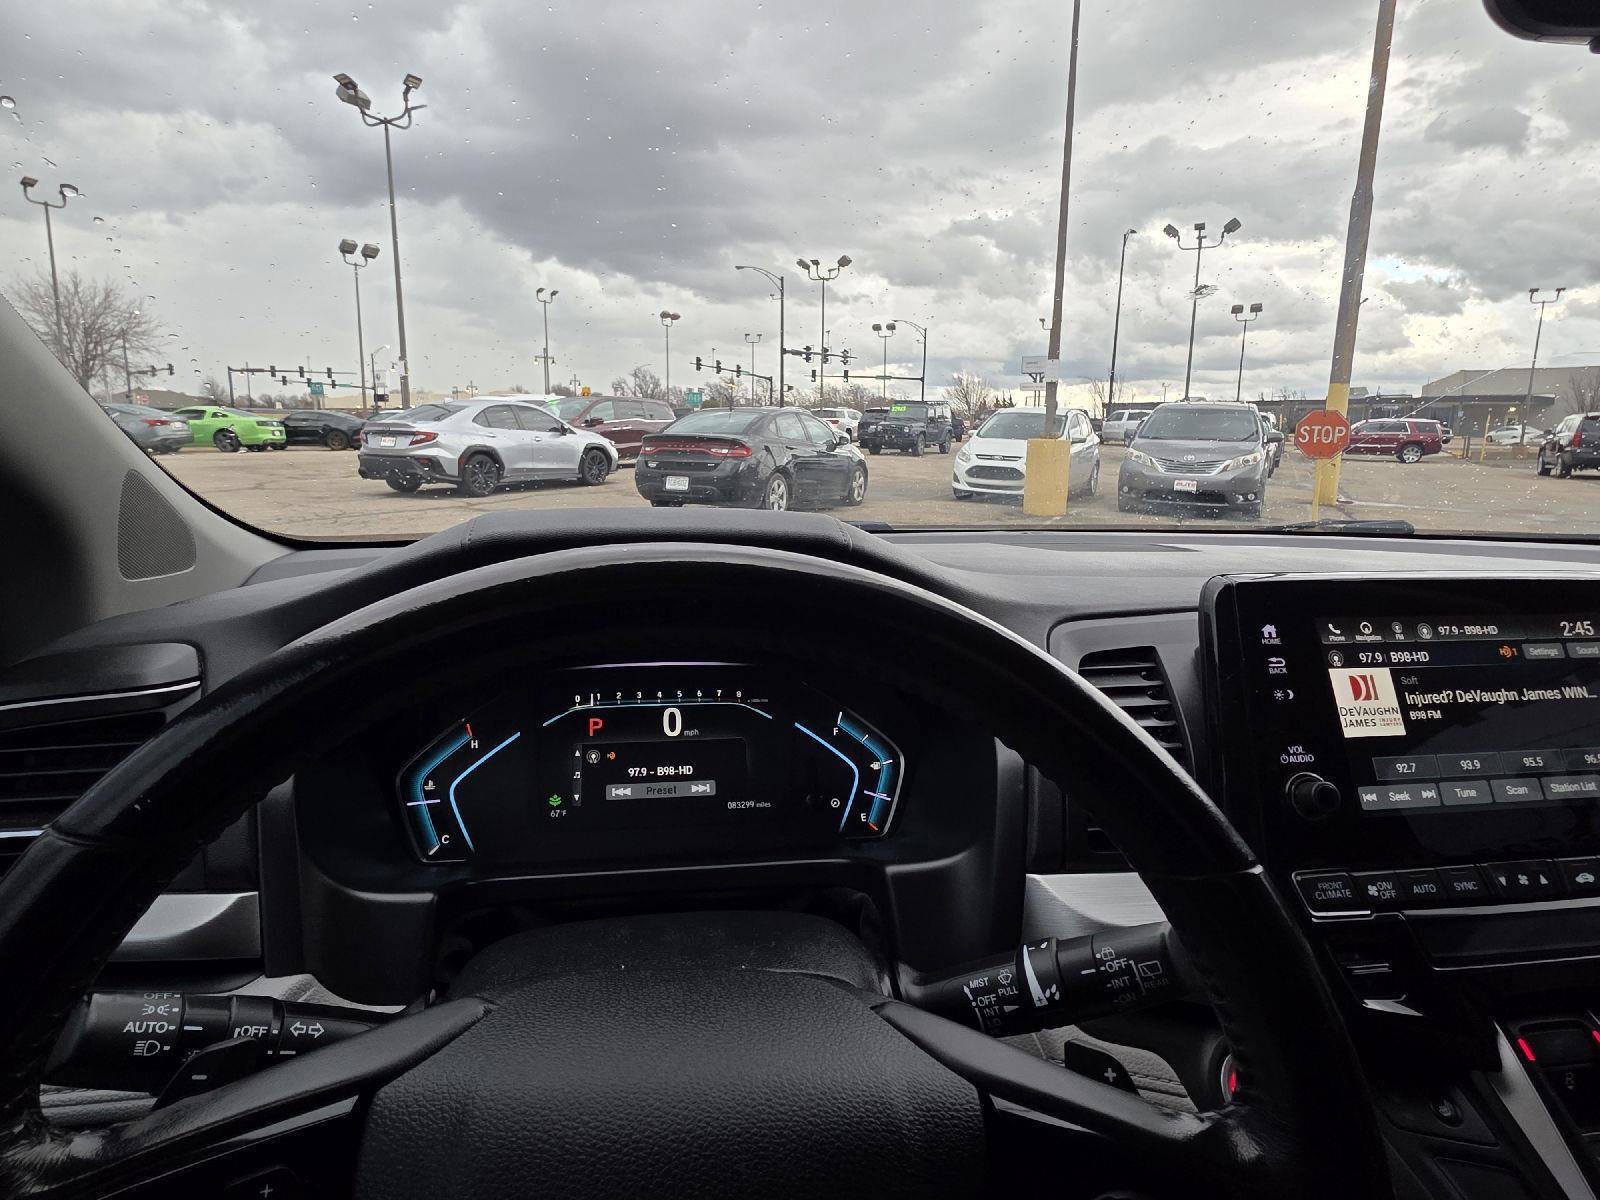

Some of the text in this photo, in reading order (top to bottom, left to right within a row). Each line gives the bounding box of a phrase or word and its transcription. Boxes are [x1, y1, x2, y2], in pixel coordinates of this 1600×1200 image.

[1299, 425, 1346, 443] STOP
[1438, 626, 1458, 635] 97.9
[1464, 625, 1498, 635] B98-HD
[1560, 621, 1594, 637] 2:45
[1529, 647, 1558, 656] Settings
[1575, 646, 1599, 655] Sound
[1359, 651, 1430, 663] 97.9 B98-HD
[1268, 667, 1288, 675] BACK
[1401, 676, 1419, 685] Soft
[636, 691, 642, 699] 3
[677, 690, 683, 698] 5
[717, 689, 722, 697] 7
[1405, 691, 1452, 707] Injured?
[1456, 689, 1519, 704] DeVaughn
[1521, 687, 1562, 700] James
[1410, 710, 1442, 720] B98 FM
[663, 707, 699, 737] 0 mph
[1343, 718, 1377, 728] JAMES
[589, 718, 603, 737] P
[833, 727, 839, 736] F
[471, 740, 479, 749] H
[1287, 746, 1306, 754] VOL
[1289, 754, 1315, 763] AUDIO
[1522, 757, 1544, 768] 95.5
[1395, 763, 1416, 773] 92.7
[1460, 759, 1481, 770] 93.9
[628, 767, 647, 777] 97.9
[657, 765, 694, 776] B98-HD
[646, 785, 677, 795] Preset
[1506, 785, 1528, 795] Scan
[1551, 781, 1598, 793] Station List
[1389, 791, 1411, 801] Seek
[1454, 788, 1477, 798] Tune
[860, 813, 867, 822] E
[441, 835, 450, 844] C
[1317, 881, 1343, 890] FRONT
[1413, 884, 1436, 894] AUTO
[1454, 881, 1479, 891] SYNC
[1315, 889, 1352, 900] CLIMATE
[1380, 890, 1396, 899] OFF
[1106, 958, 1128, 973] OFF
[969, 977, 989, 988] MIST
[1111, 976, 1130, 988] INT
[998, 986, 1018, 996] PULL
[977, 994, 997, 1006] OFF
[984, 1006, 1000, 1016] INT
[123, 1022, 169, 1034] AUTO
[241, 1025, 268, 1037] OFF
